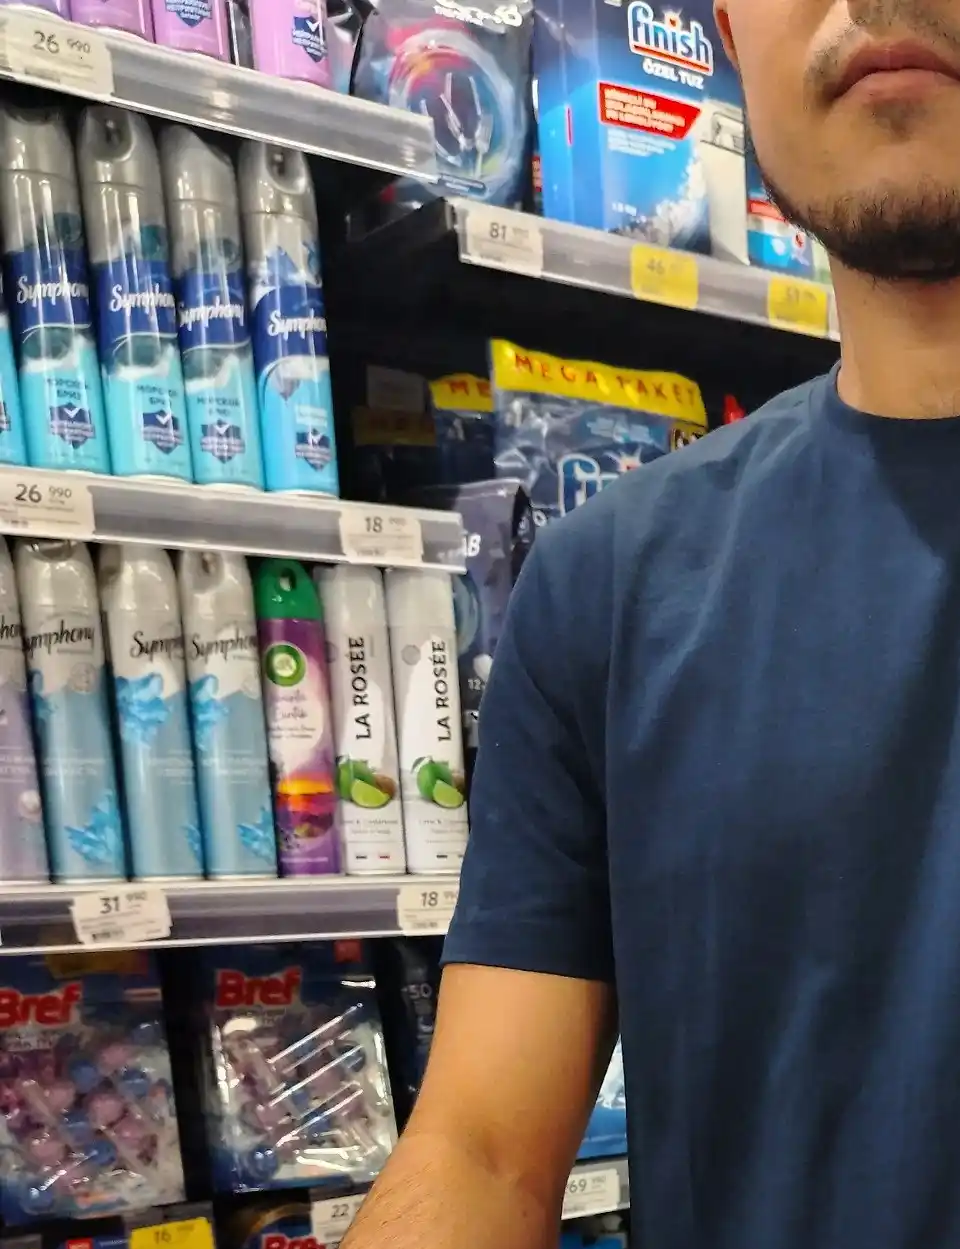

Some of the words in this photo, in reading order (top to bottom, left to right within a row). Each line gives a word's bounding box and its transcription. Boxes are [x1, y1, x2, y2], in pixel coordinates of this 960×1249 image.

[33, 30, 60, 54] 26
[629, 1, 713, 66] finish
[514, 353, 598, 389] MEGA
[446, 379, 491, 397] ME
[14, 483, 43, 503] 26
[48, 485, 73, 498] 990
[364, 516, 383, 533] 18
[428, 640, 450, 709] ROSÉE
[355, 713, 372, 741] LA
[437, 716, 452, 743] LA
[100, 896, 120, 914] 31
[421, 891, 439, 907] 18
[216, 965, 302, 1009] Bref
[0, 982, 83, 1028] Bref
